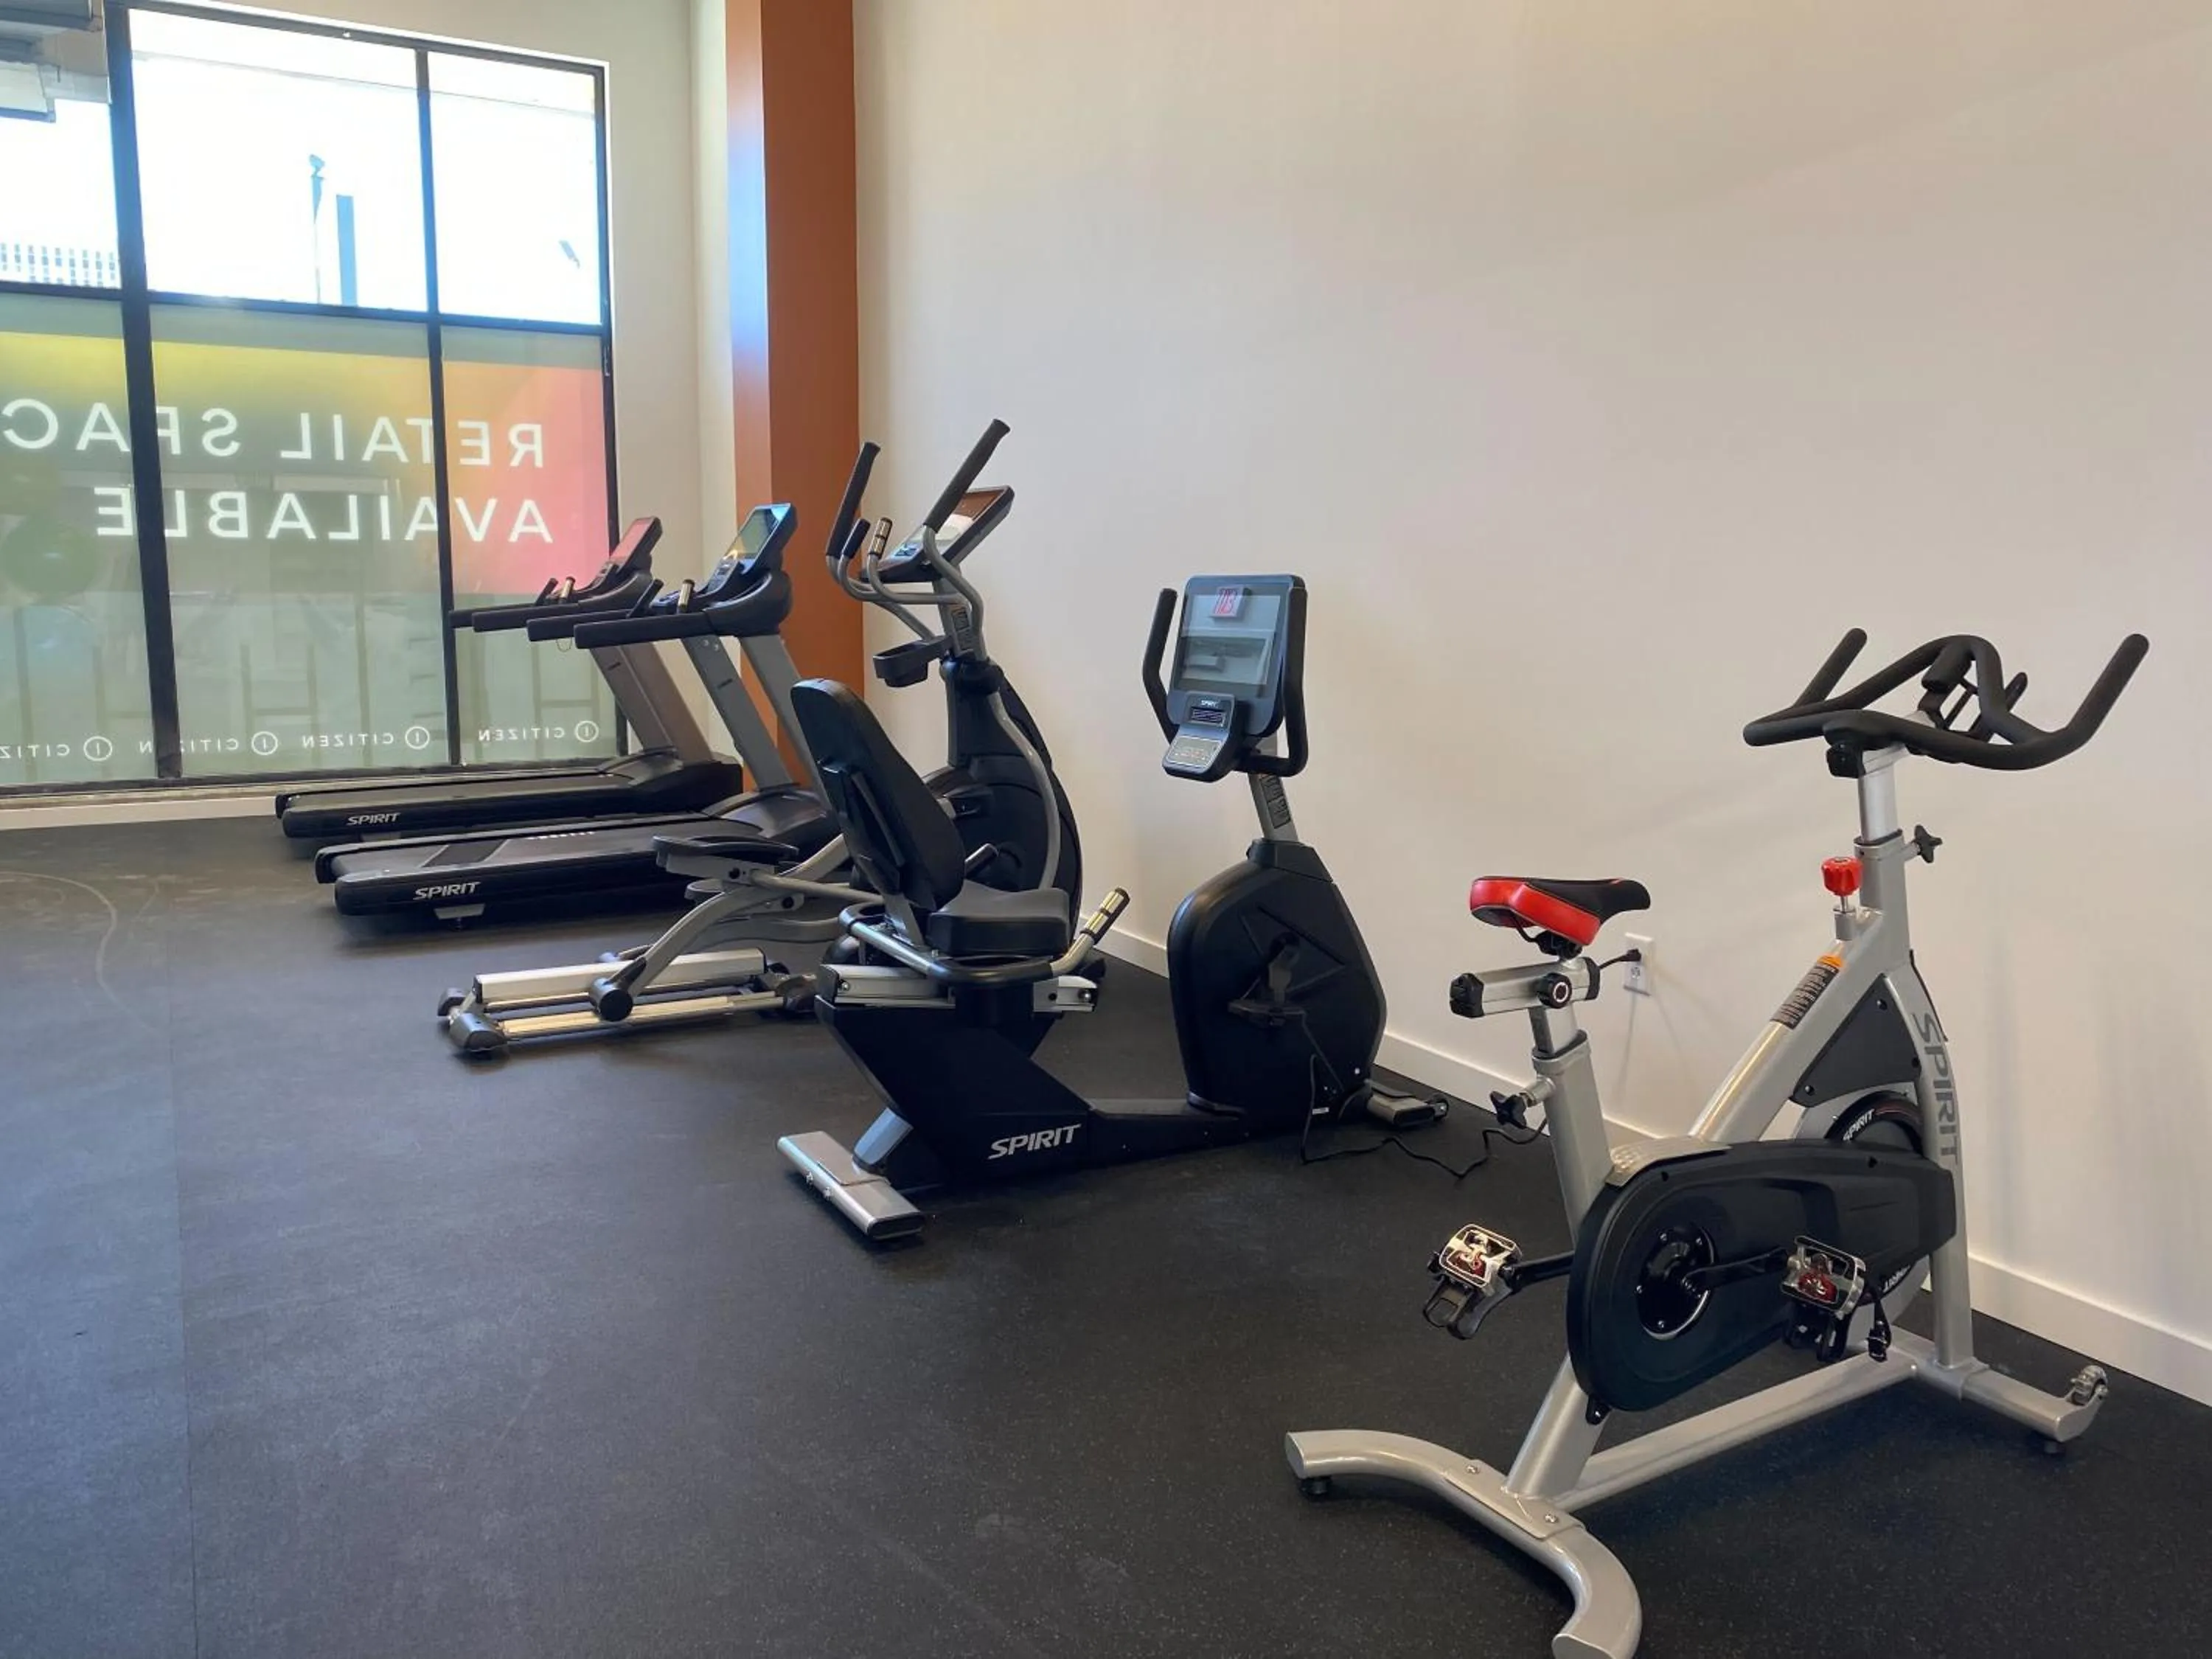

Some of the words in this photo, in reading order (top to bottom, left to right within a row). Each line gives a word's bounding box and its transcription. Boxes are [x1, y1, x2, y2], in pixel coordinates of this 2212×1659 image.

[347, 812, 401, 826] SPIRIT
[412, 881, 481, 900] SPIRIT
[1911, 1012, 1958, 1165] SPIRIT
[1843, 1108, 1875, 1141] SPIRIT
[987, 1123, 1082, 1160] SPIRIT
